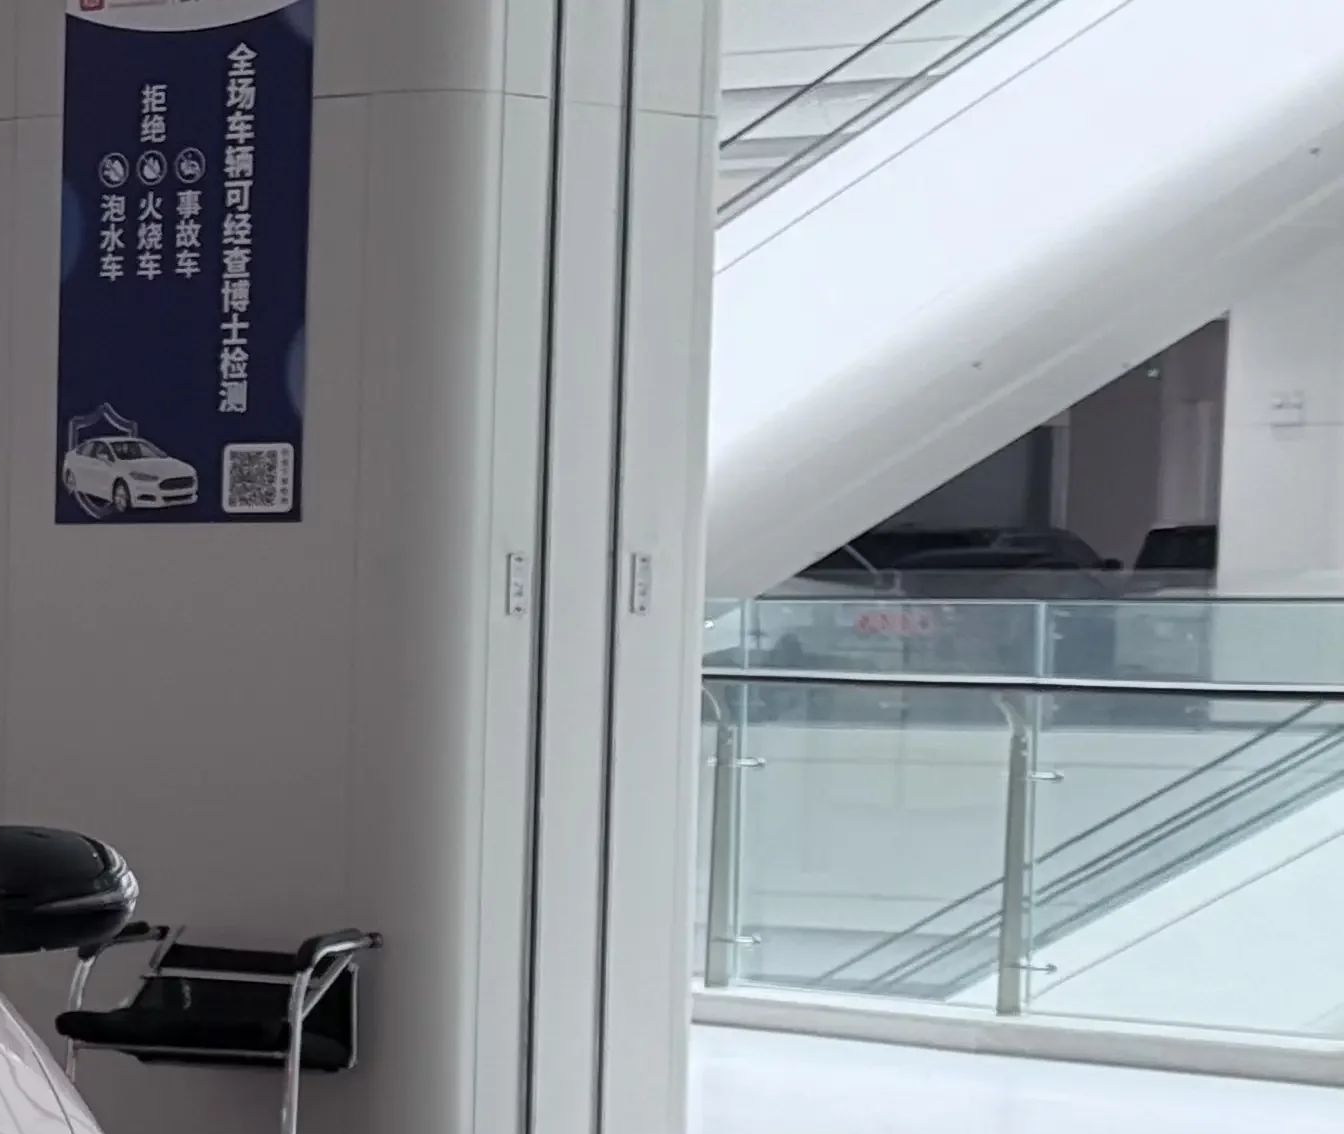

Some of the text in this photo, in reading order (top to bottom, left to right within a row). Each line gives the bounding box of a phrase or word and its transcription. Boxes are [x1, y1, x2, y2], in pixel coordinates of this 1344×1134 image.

[140, 84, 167, 143] 拒绝
[99, 194, 126, 282] 泡水车
[136, 191, 163, 281] 火烧车
[175, 189, 202, 279] 事故车
[219, 42, 258, 413] 全场车辆可经查博士检测
